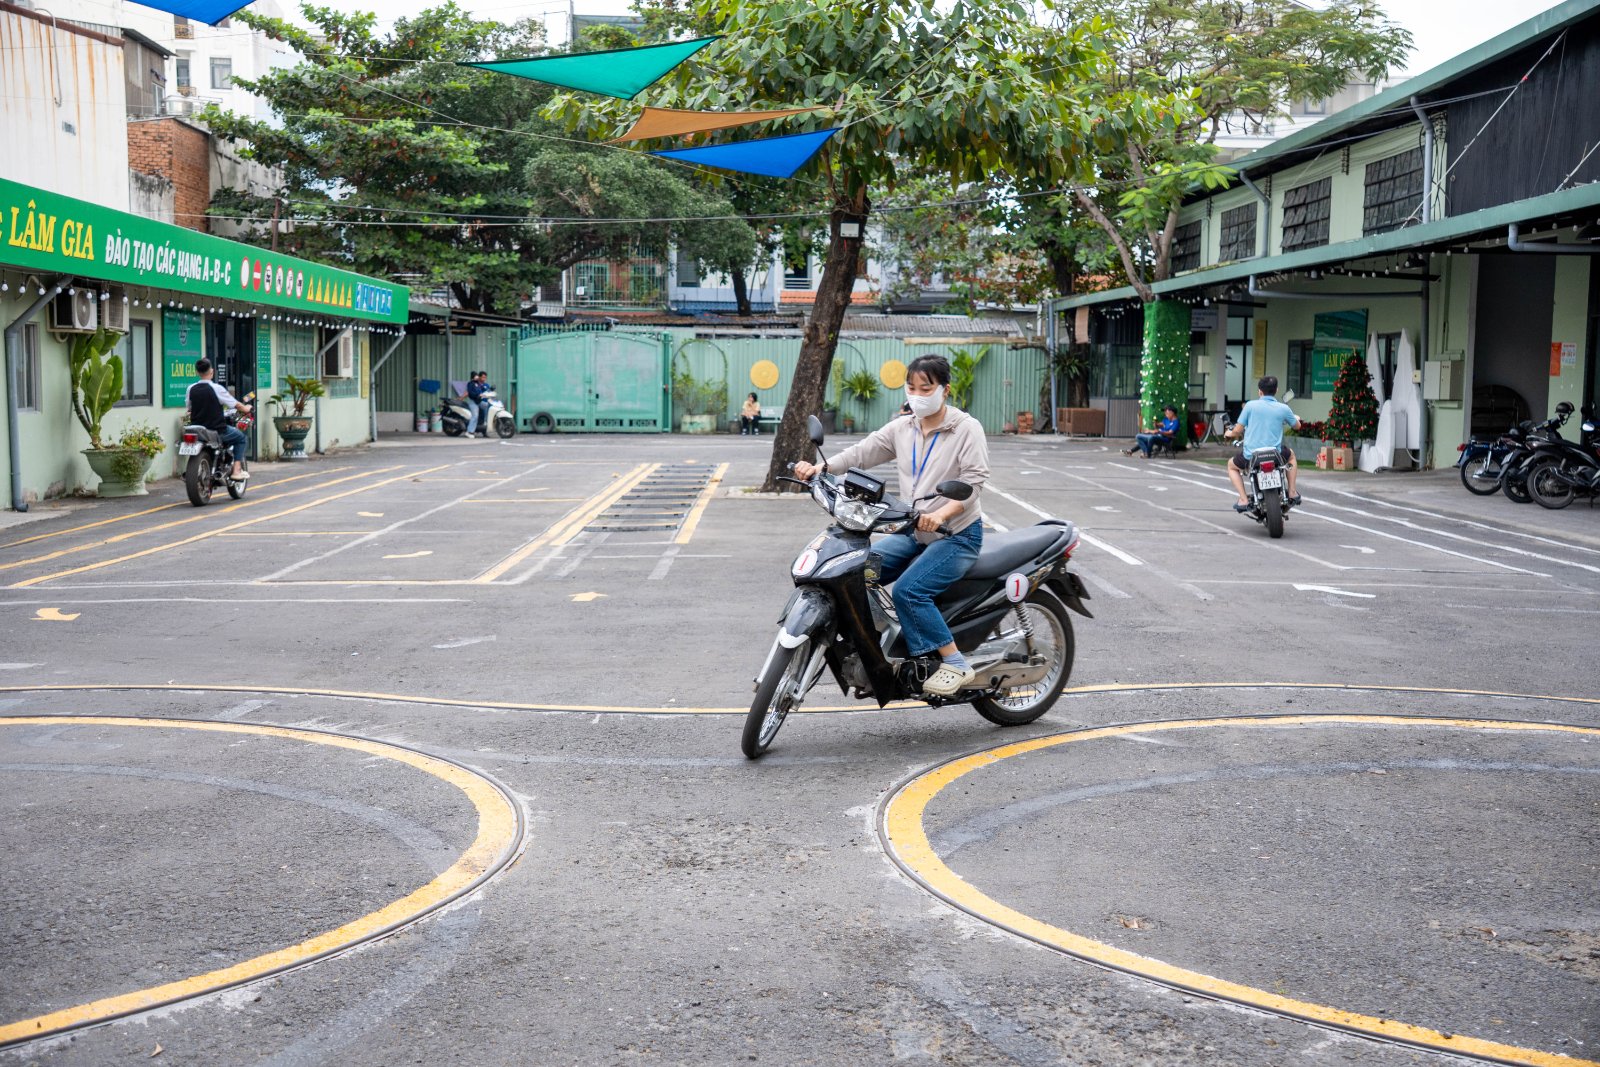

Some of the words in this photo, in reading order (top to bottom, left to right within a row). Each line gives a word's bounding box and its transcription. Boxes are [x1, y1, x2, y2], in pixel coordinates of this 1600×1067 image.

[8, 199, 57, 253] LÂM
[61, 219, 95, 261] GIA
[105, 228, 131, 267] ĐÀO
[133, 240, 155, 275] TẠO
[156, 240, 176, 275] CÁC
[177, 250, 202, 283] HẠNG
[1012, 578, 1021, 597] 1
